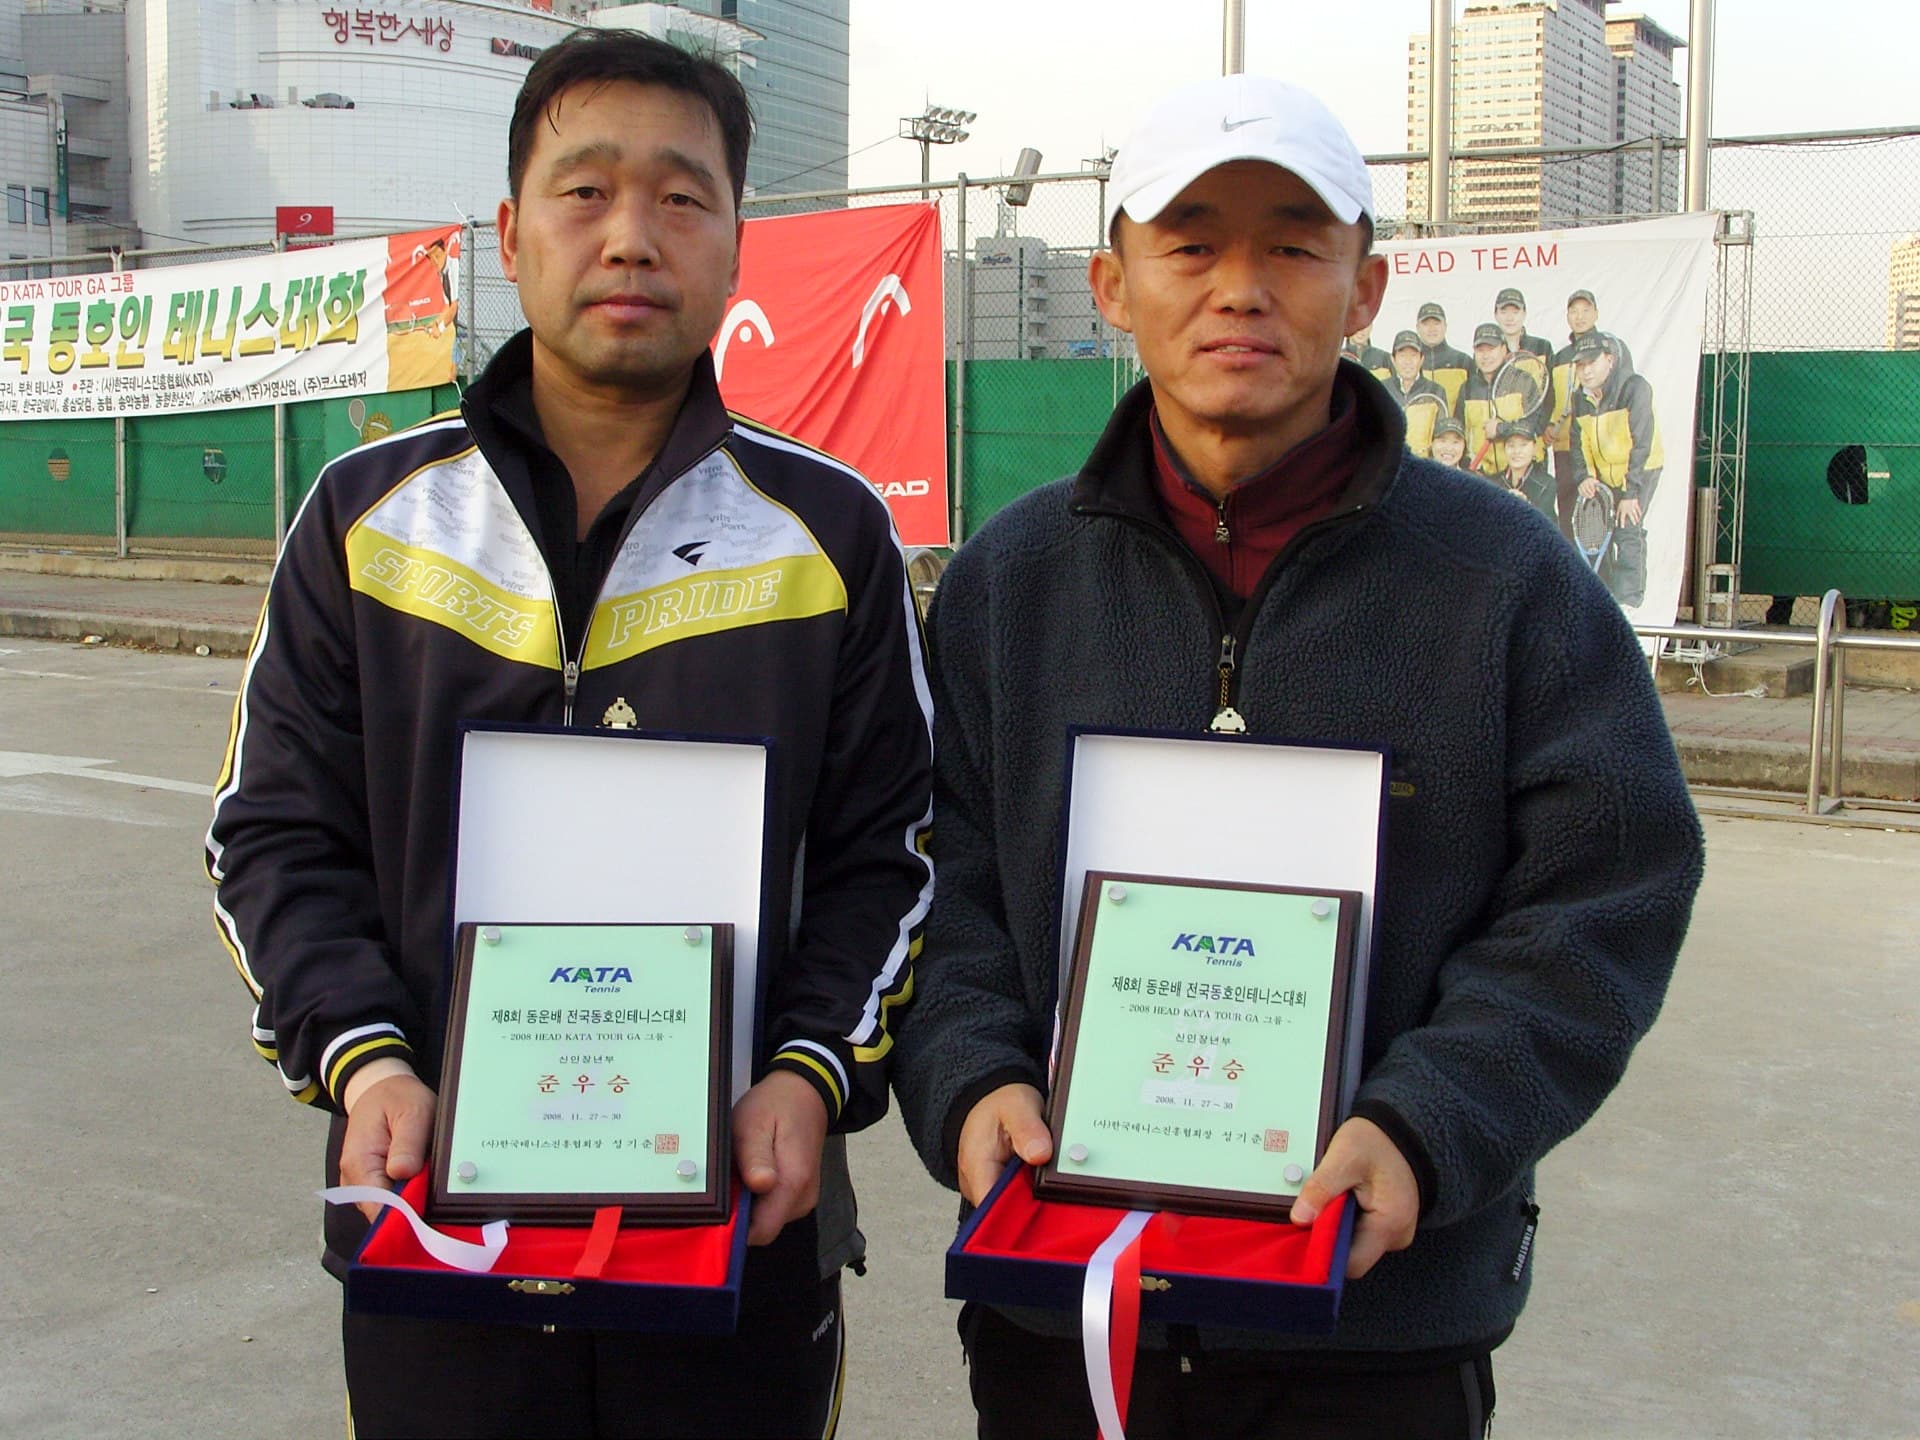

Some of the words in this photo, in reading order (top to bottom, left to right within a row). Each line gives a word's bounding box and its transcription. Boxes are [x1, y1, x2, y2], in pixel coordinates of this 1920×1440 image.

[322, 8, 455, 52] 행복한세상
[1385, 250, 1455, 275] EAD
[1472, 243, 1558, 272] TEAM
[13, 284, 44, 301] KATA
[49, 279, 83, 298] TOUR
[87, 278, 106, 295] GA
[111, 273, 135, 293] 그룹
[48, 295, 153, 374] 동호인
[163, 269, 367, 366] 테니스대회
[18, 382, 33, 396] 부천
[35, 380, 63, 396] 테니스장
[79, 379, 94, 394] 주관
[874, 479, 929, 497] EAD
[361, 548, 538, 648] SPORTS
[606, 569, 783, 650] PRIDE
[1171, 933, 1256, 957] KATA
[1205, 956, 1243, 968] Tennis
[549, 967, 633, 983] KATA
[584, 985, 621, 993] Tennis
[1111, 975, 1142, 993] 제8회
[1146, 978, 1182, 997] 동운배
[1186, 981, 1308, 1007] 전국동호인테니스대회
[491, 1009, 522, 1024] 제8회
[526, 1009, 562, 1024] 동운배
[567, 1008, 687, 1024] 전국동호인테니스대회
[1129, 1004, 1151, 1013] 2008
[1153, 1005, 1180, 1016] HEAD
[1183, 1009, 1211, 1019] KATA
[1215, 1011, 1242, 1022] TOUR
[1245, 1014, 1259, 1024] GA
[510, 1033, 532, 1041] 2008
[535, 1033, 562, 1041] HEAD
[565, 1033, 592, 1041] KATA
[598, 1033, 623, 1041] TOUR
[627, 1033, 641, 1041] GA
